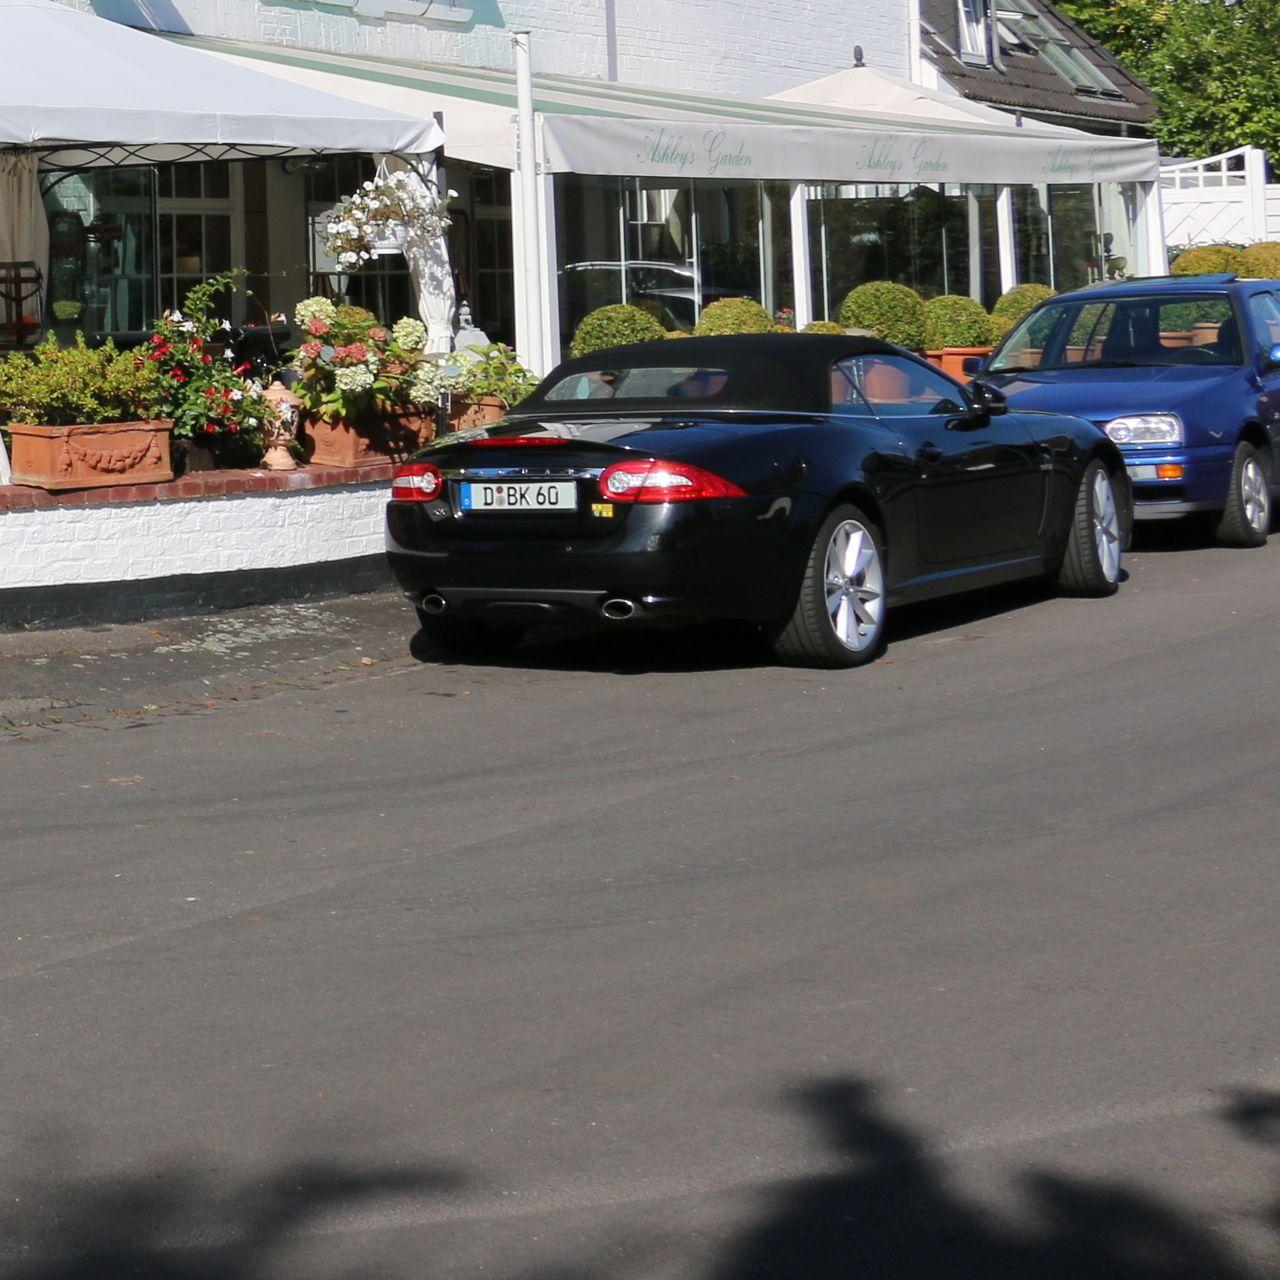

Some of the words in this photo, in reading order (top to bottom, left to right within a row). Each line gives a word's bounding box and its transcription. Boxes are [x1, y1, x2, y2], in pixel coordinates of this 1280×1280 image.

[637, 128, 694, 174] Ashley's
[703, 130, 752, 175] Garden
[483, 487, 494, 506] D
[507, 486, 530, 506] BK
[536, 485, 559, 506] 60
